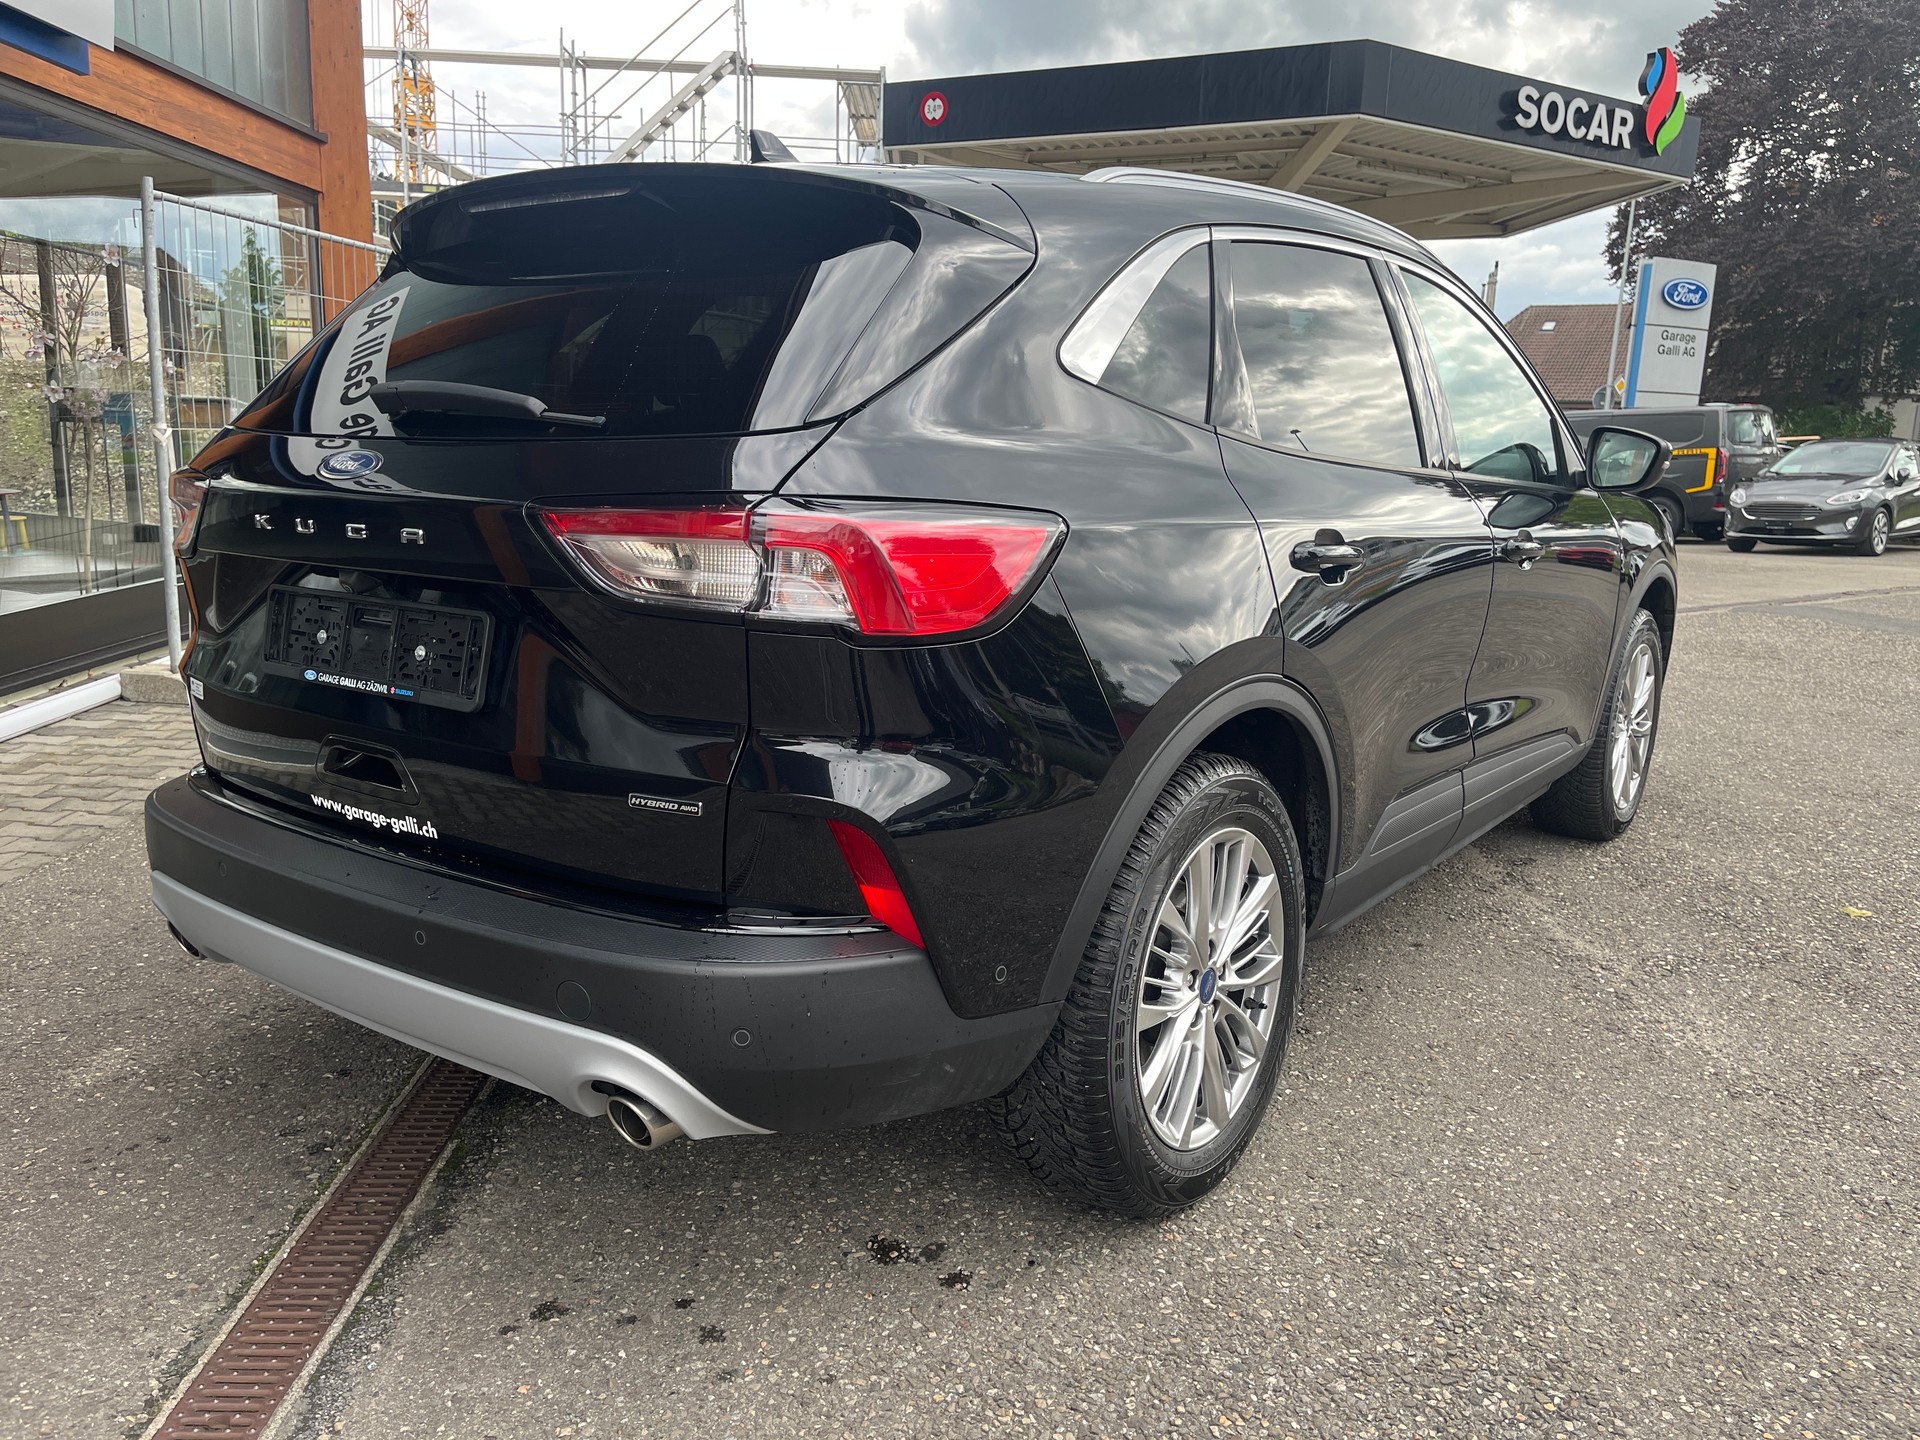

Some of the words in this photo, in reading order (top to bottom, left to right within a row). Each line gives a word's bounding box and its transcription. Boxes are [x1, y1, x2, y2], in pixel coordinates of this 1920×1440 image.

[1515, 85, 1634, 149] SOCAR
[1673, 282, 1702, 304] Ford
[1661, 329, 1696, 345] Garage
[1657, 344, 1680, 356] Galli
[1682, 346, 1696, 357] AG
[254, 514, 424, 545] KUGA
[317, 672, 340, 685] GARAGE
[339, 676, 357, 688] GALLI
[356, 680, 367, 690] AG
[395, 688, 414, 697] SUZUKI
[631, 797, 679, 810] HYBRID
[310, 793, 438, 840] www.garage-galli.ch
